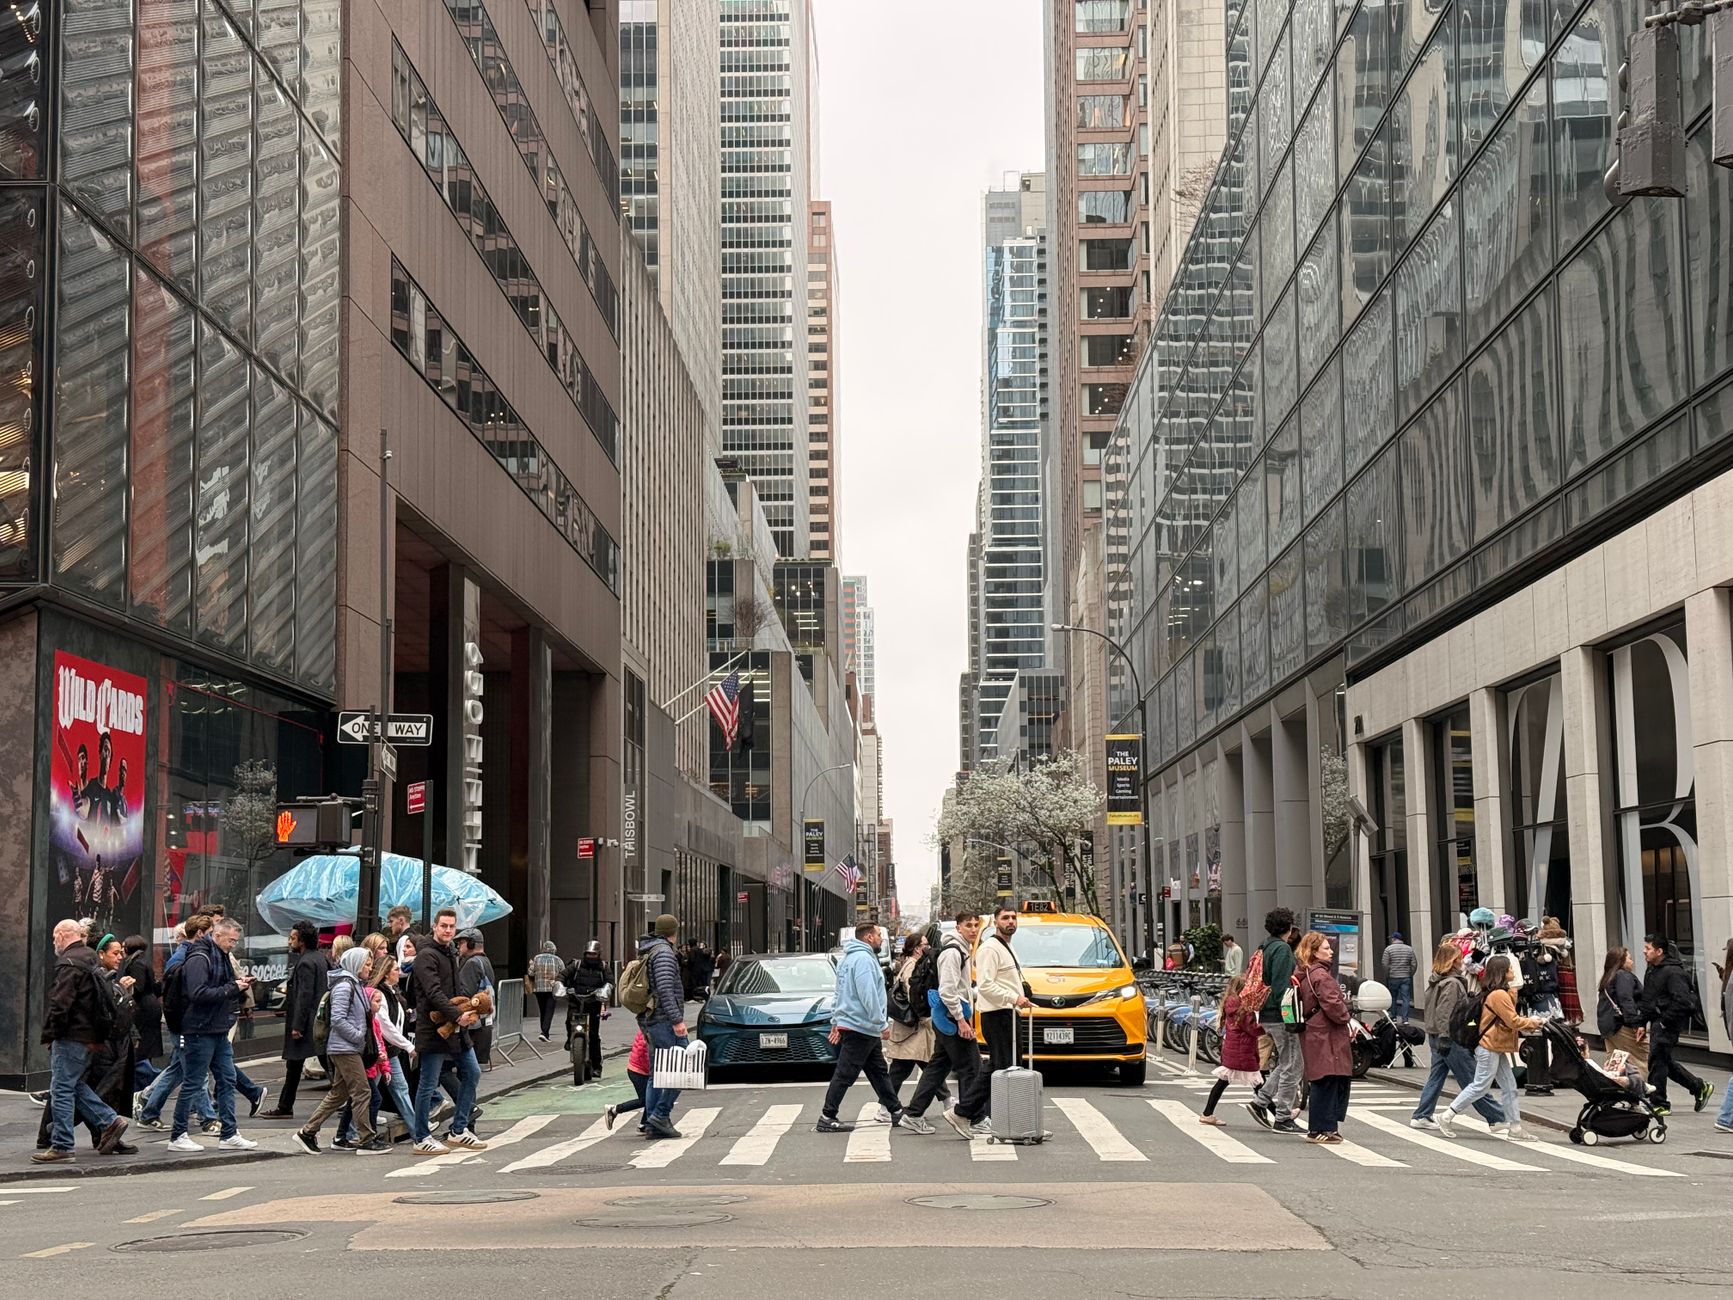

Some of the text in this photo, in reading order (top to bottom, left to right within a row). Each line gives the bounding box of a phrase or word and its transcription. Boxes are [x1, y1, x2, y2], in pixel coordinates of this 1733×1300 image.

[58, 665, 144, 736] WILD CARDS
[351, 722, 423, 735] ONE WAY
[1108, 757, 1138, 765] PALEY
[625, 790, 636, 859] THISBOWL
[251, 964, 288, 982] soccer
